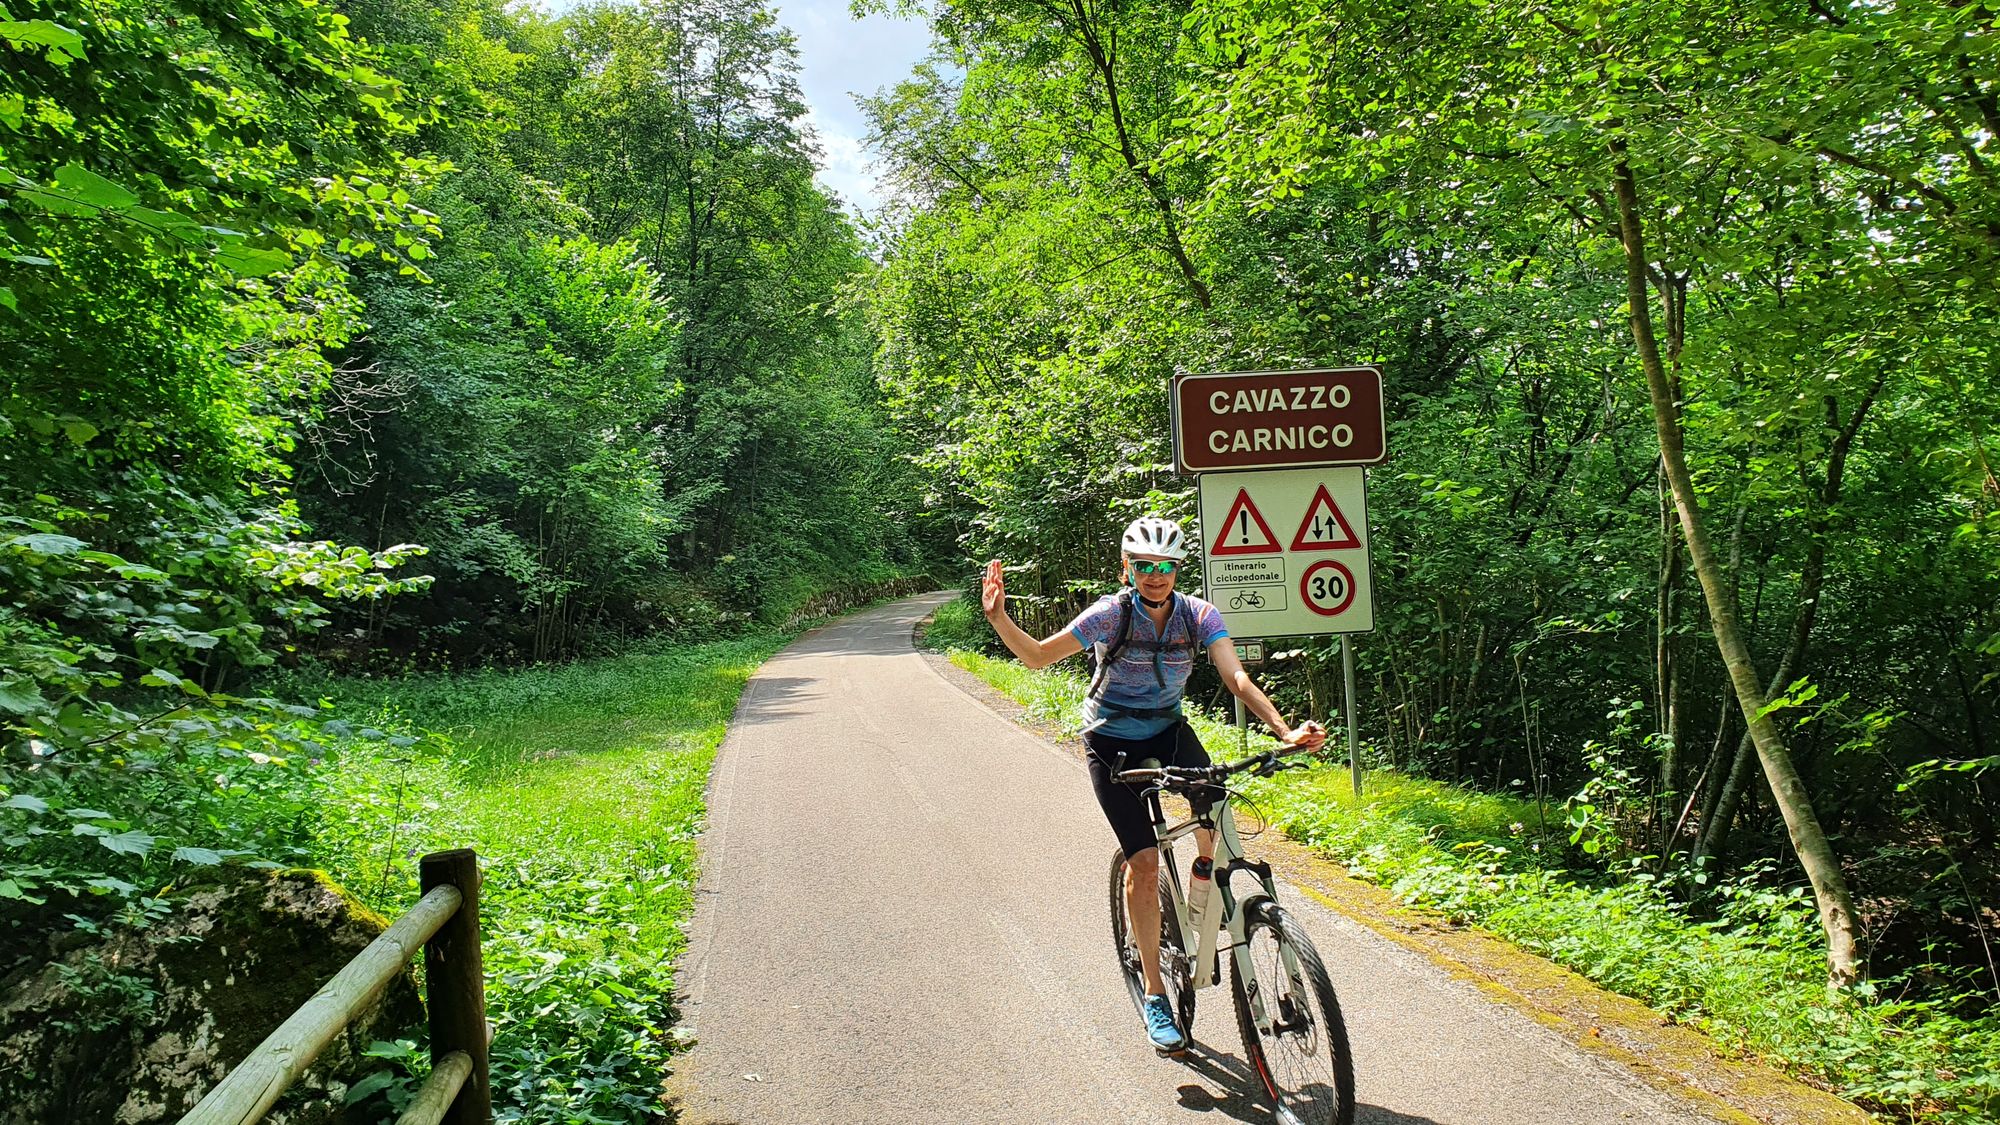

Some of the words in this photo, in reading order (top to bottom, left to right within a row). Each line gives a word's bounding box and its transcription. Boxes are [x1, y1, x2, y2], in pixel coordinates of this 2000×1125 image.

[1209, 385, 1351, 415] CAVAZZO
[1208, 424, 1354, 454] CARNICO
[1215, 572, 1280, 583] ciclopedonale
[1224, 561, 1267, 571] itinerario
[1312, 576, 1344, 600] 30
